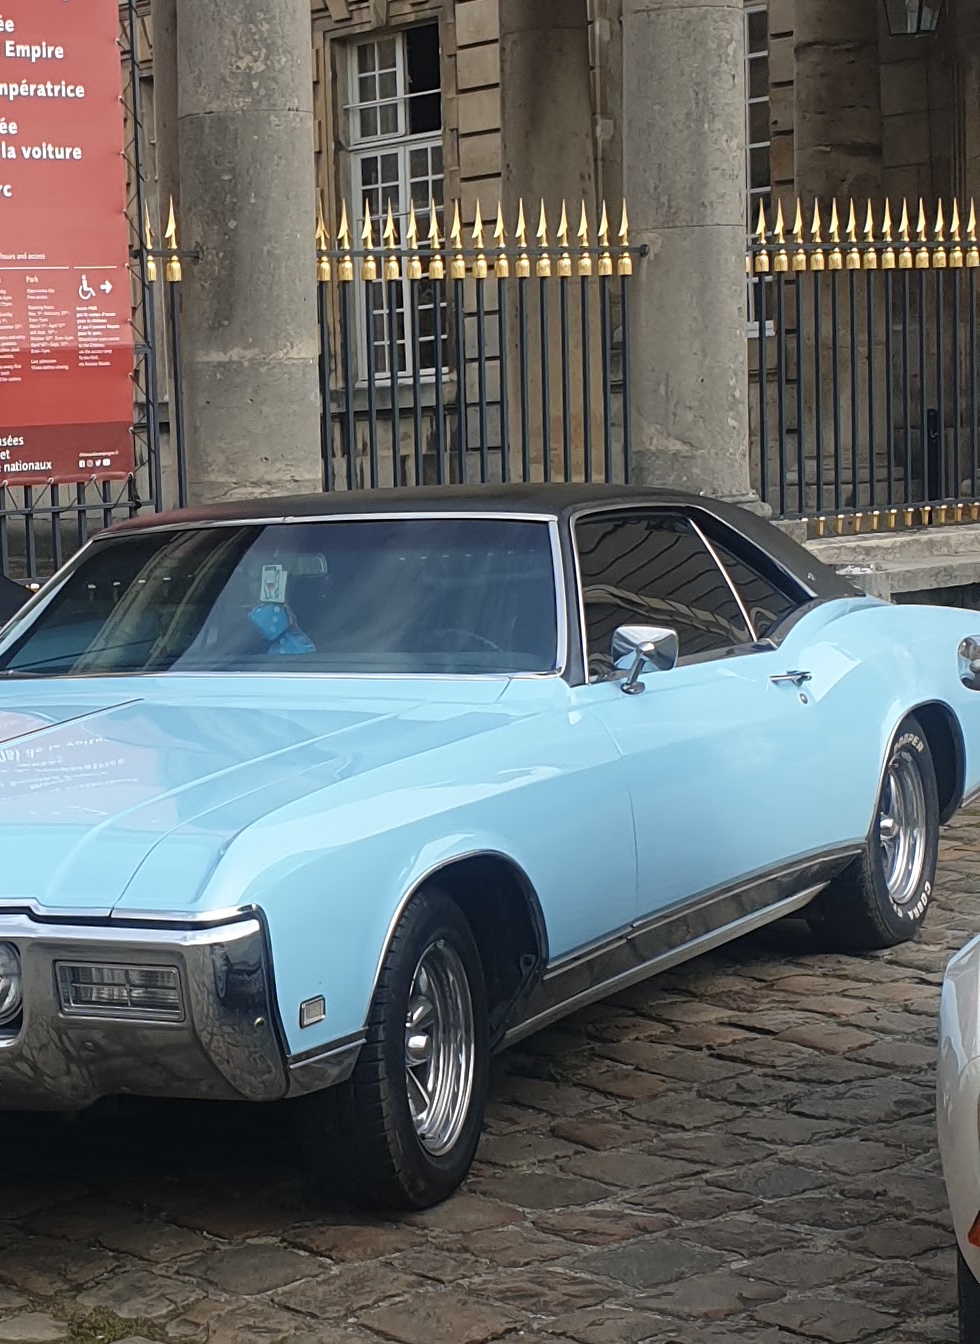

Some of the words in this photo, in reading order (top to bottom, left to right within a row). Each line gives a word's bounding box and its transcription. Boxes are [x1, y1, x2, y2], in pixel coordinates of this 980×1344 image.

[5, 40, 64, 62] Empire
[1, 141, 16, 159] la
[21, 143, 82, 159] voiture
[0, 449, 10, 460] et
[3, 460, 52, 473] nationaux
